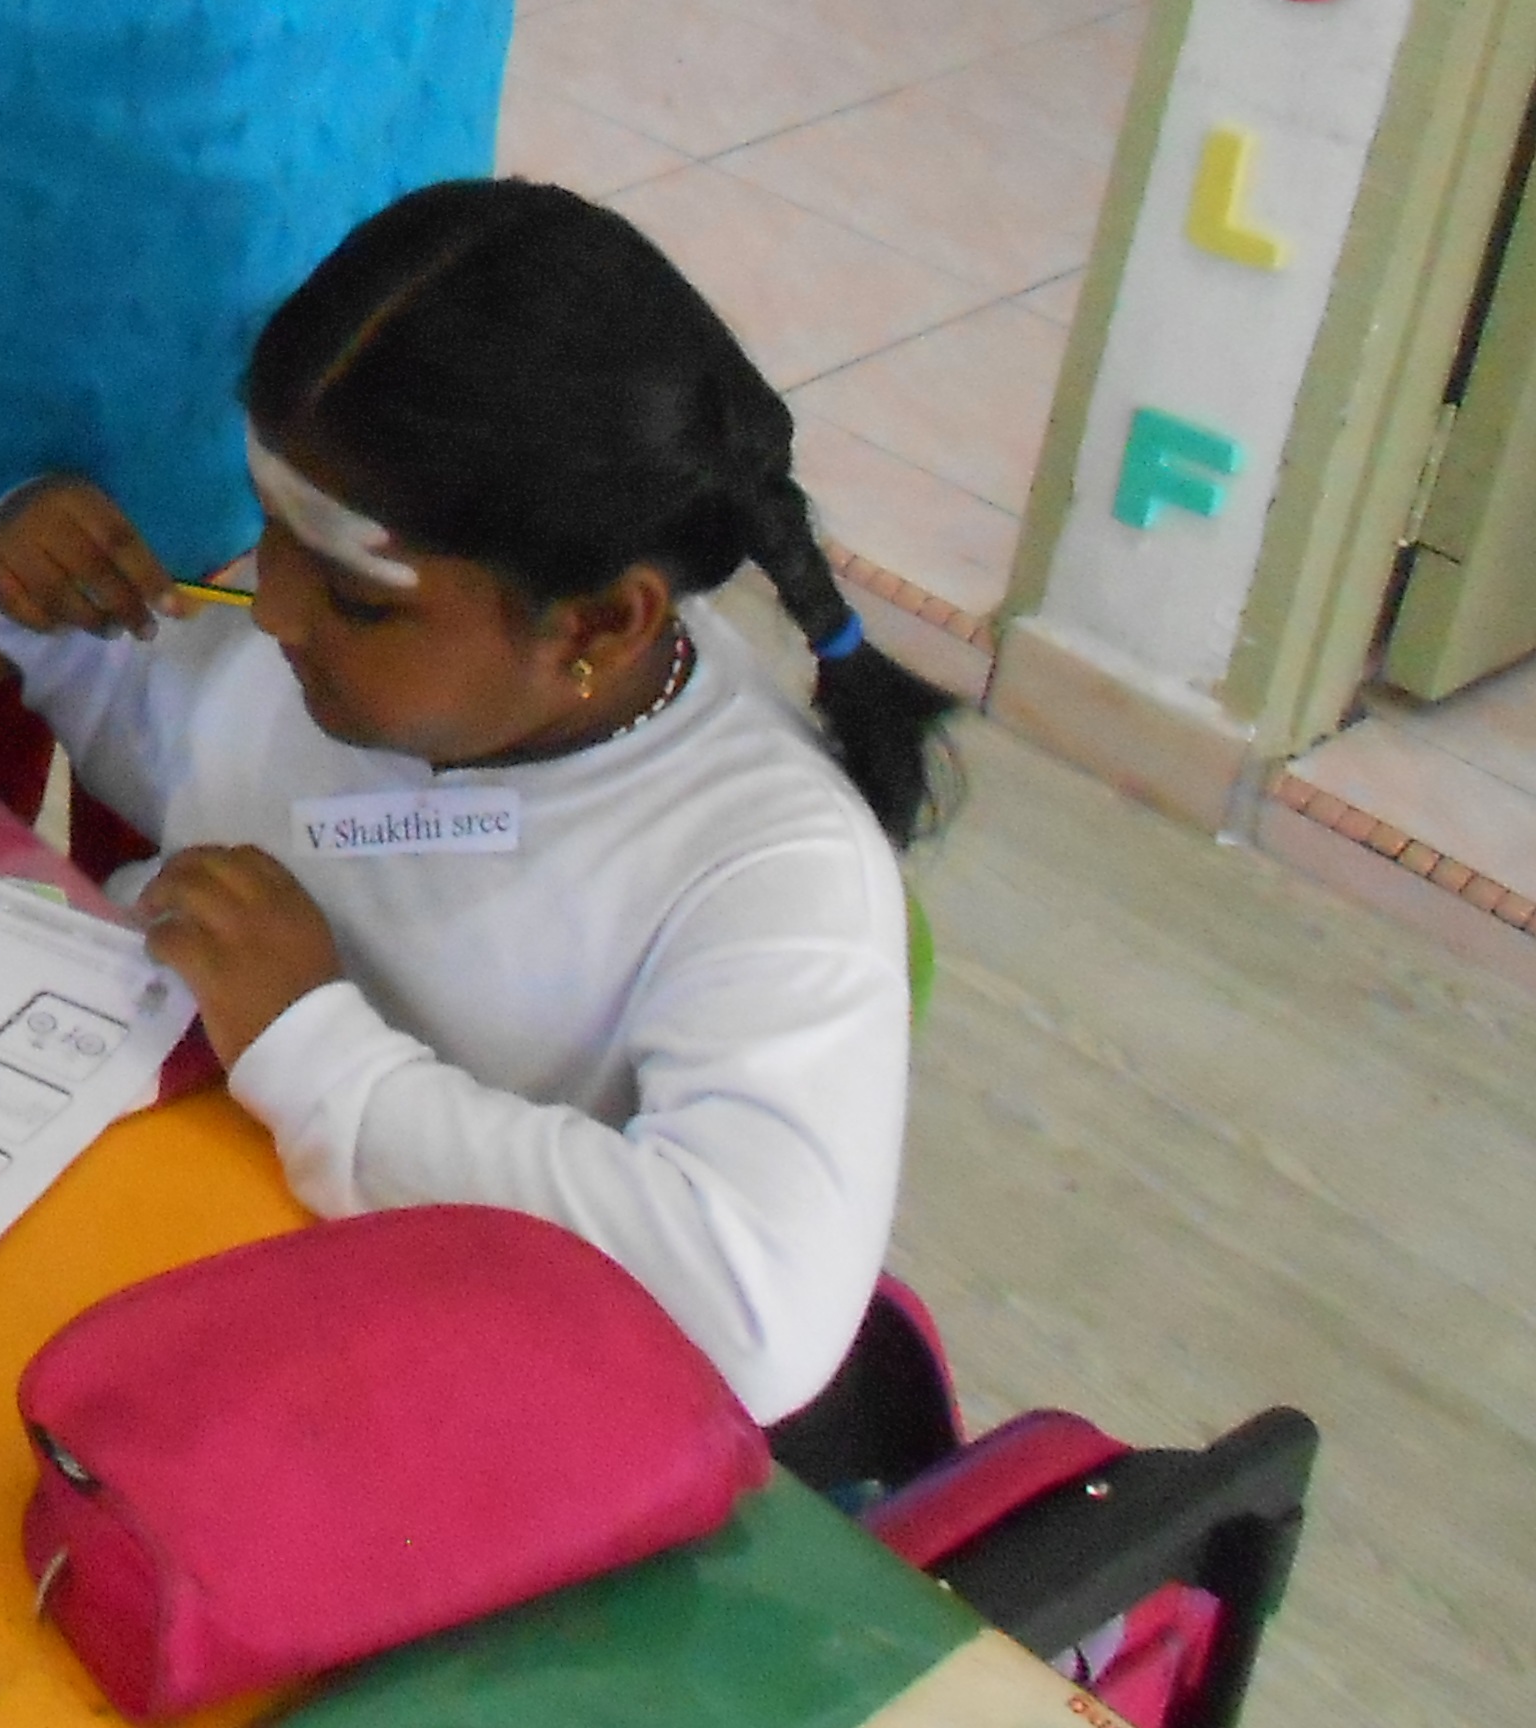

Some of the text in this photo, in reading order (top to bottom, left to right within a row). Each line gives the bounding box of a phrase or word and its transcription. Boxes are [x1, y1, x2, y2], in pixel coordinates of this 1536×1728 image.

[1186, 123, 1290, 270] L
[1112, 404, 1242, 529] F
[306, 822, 326, 849] V
[334, 810, 443, 850] Shakthi
